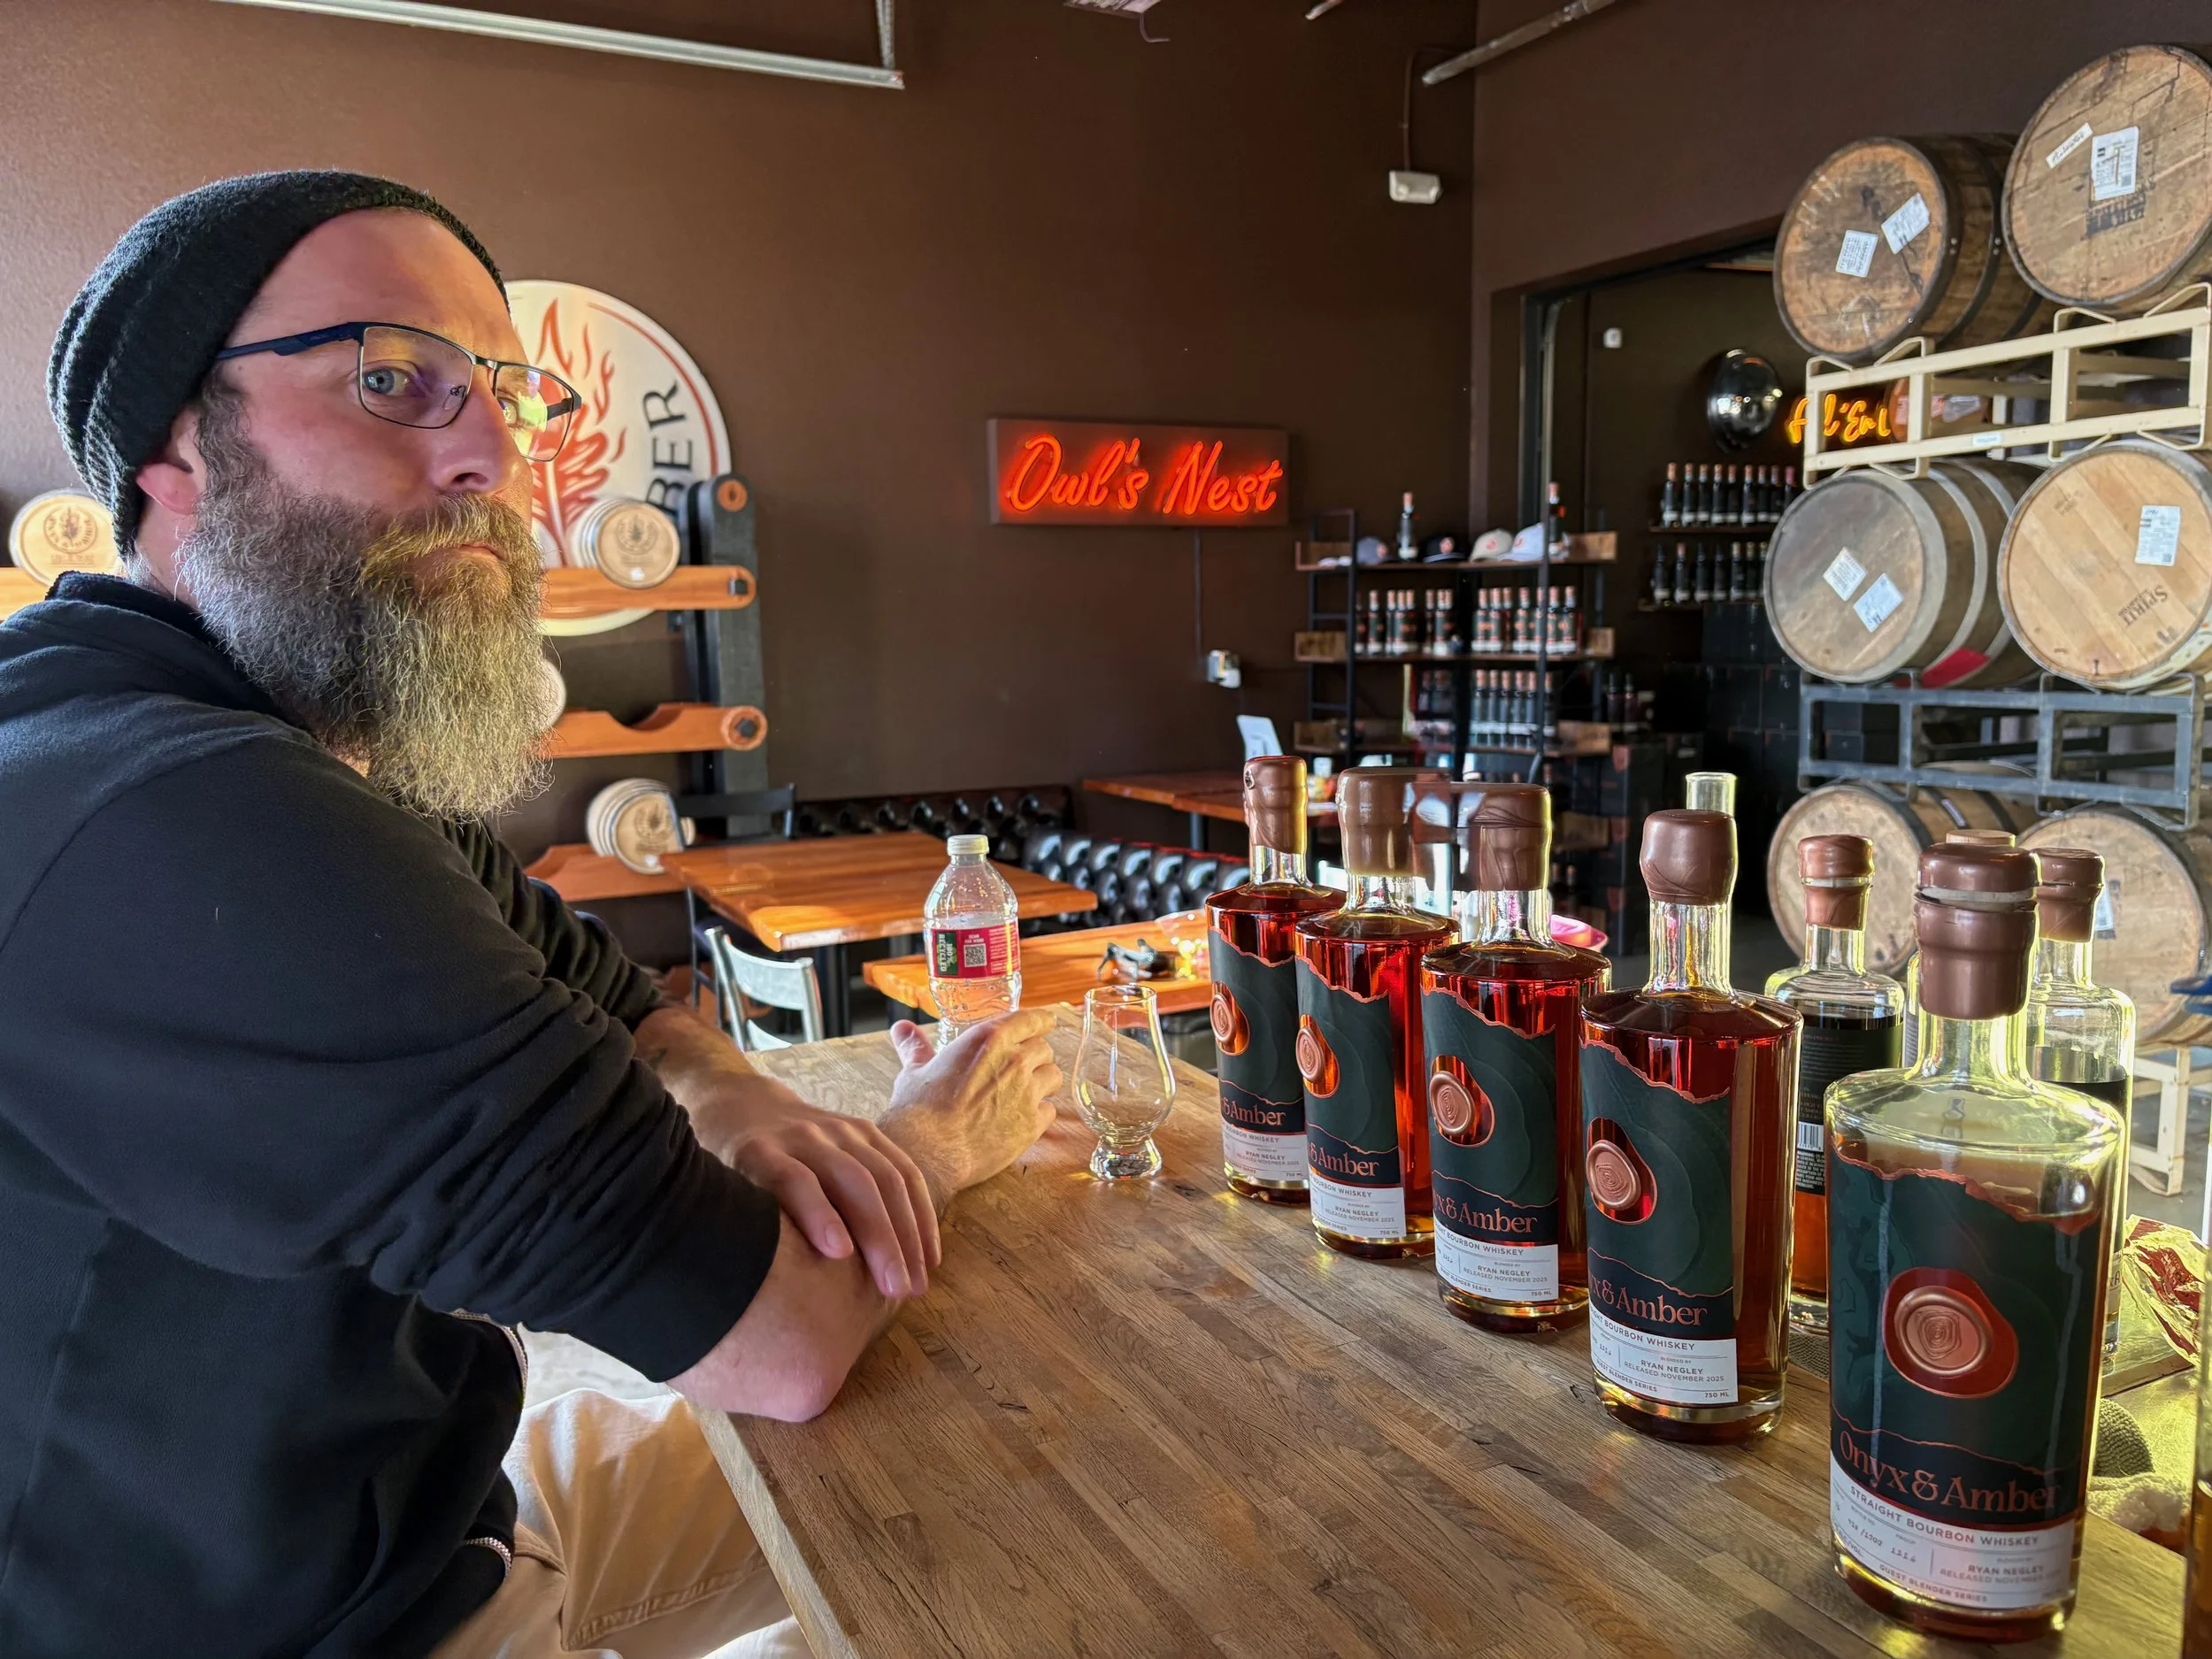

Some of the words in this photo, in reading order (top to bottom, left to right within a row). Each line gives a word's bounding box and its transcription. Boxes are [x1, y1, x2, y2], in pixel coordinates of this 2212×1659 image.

[1010, 434, 1149, 511] Owl's
[1163, 441, 1284, 515] Nest
[1339, 1187, 1371, 1197] WHISKEY
[1447, 1231, 1480, 1250] BOURBON
[1483, 1246, 1524, 1256] WHISKEY
[1463, 1267, 1493, 1280] RELEASED
[1478, 1265, 1497, 1274] RYAN
[1500, 1268, 1530, 1277] NEGLEY
[1471, 1283, 1492, 1293] SERIES
[1604, 1318, 1643, 1342] BOURBON
[1647, 1337, 1695, 1351] WHISKEY
[1624, 1361, 1659, 1377] RELEASED
[1661, 1372, 1704, 1382] NOVEMBER
[1640, 1359, 1663, 1371] RYAN
[1667, 1364, 1703, 1375] NEGLEY
[1609, 1368, 1633, 1385] BLENDER
[1634, 1381, 1657, 1392] SERIES
[1850, 1486, 1902, 1523] STRAIGHT
[1906, 1517, 1975, 1543] BOURBON
[1980, 1536, 2039, 1547] WHISKEY
[1940, 1568, 1992, 1583] RELEASED
[1968, 1564, 2000, 1575] RYAN
[2002, 1564, 2043, 1575] NEGLEY
[1878, 1563, 1906, 1580] GUEST
[1909, 1578, 1952, 1596] BLENDER
[1955, 1592, 1987, 1602] SERIES
